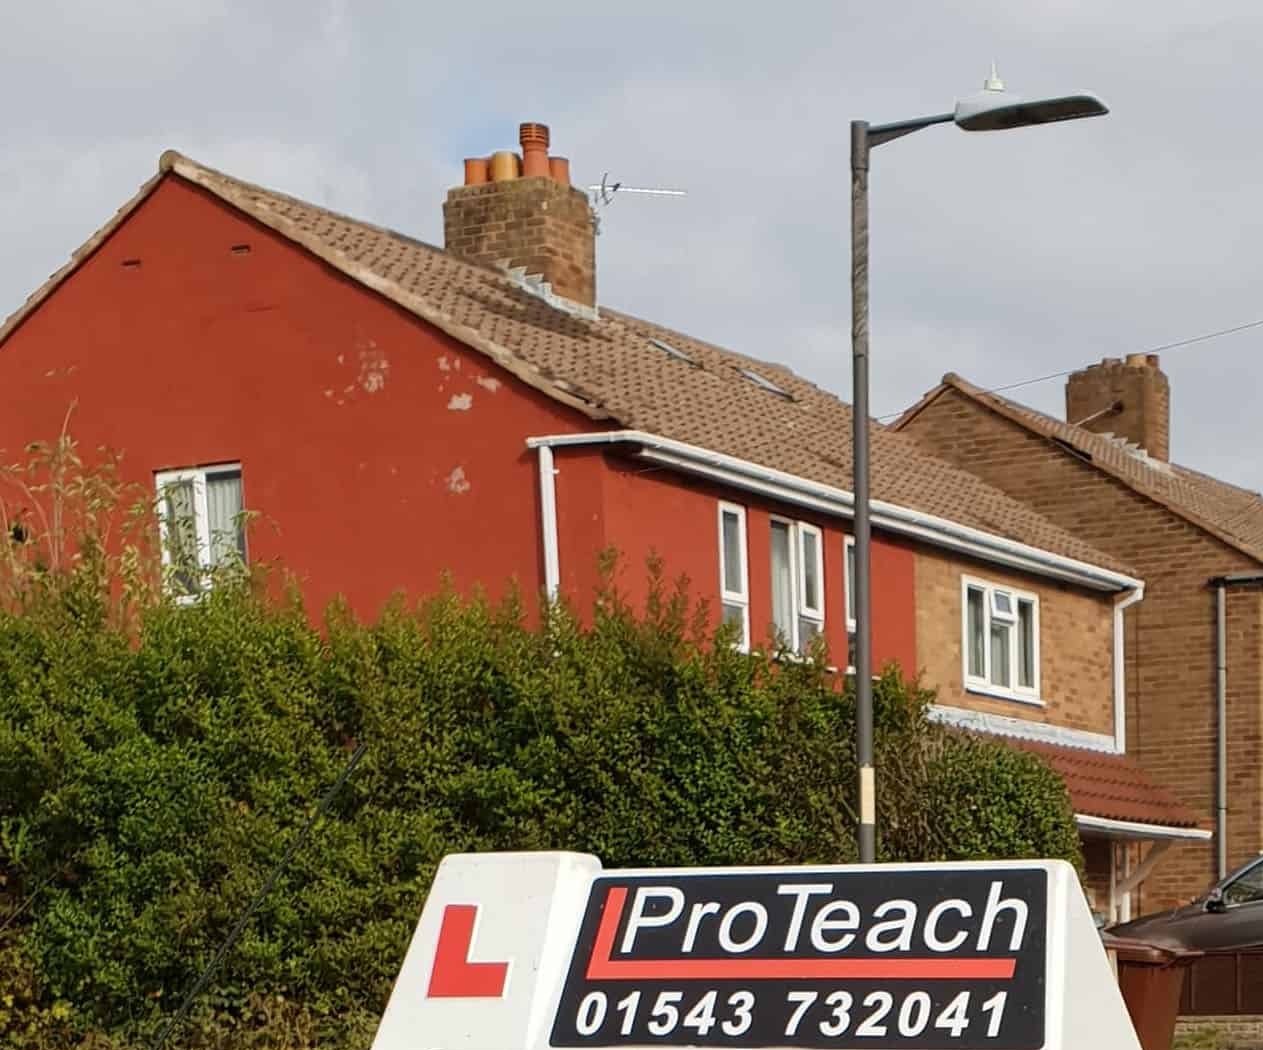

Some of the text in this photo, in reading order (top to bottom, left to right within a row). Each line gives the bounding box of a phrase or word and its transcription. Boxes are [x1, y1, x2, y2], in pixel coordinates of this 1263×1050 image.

[427, 904, 509, 998] L
[575, 990, 1008, 1037] 01543 732041
